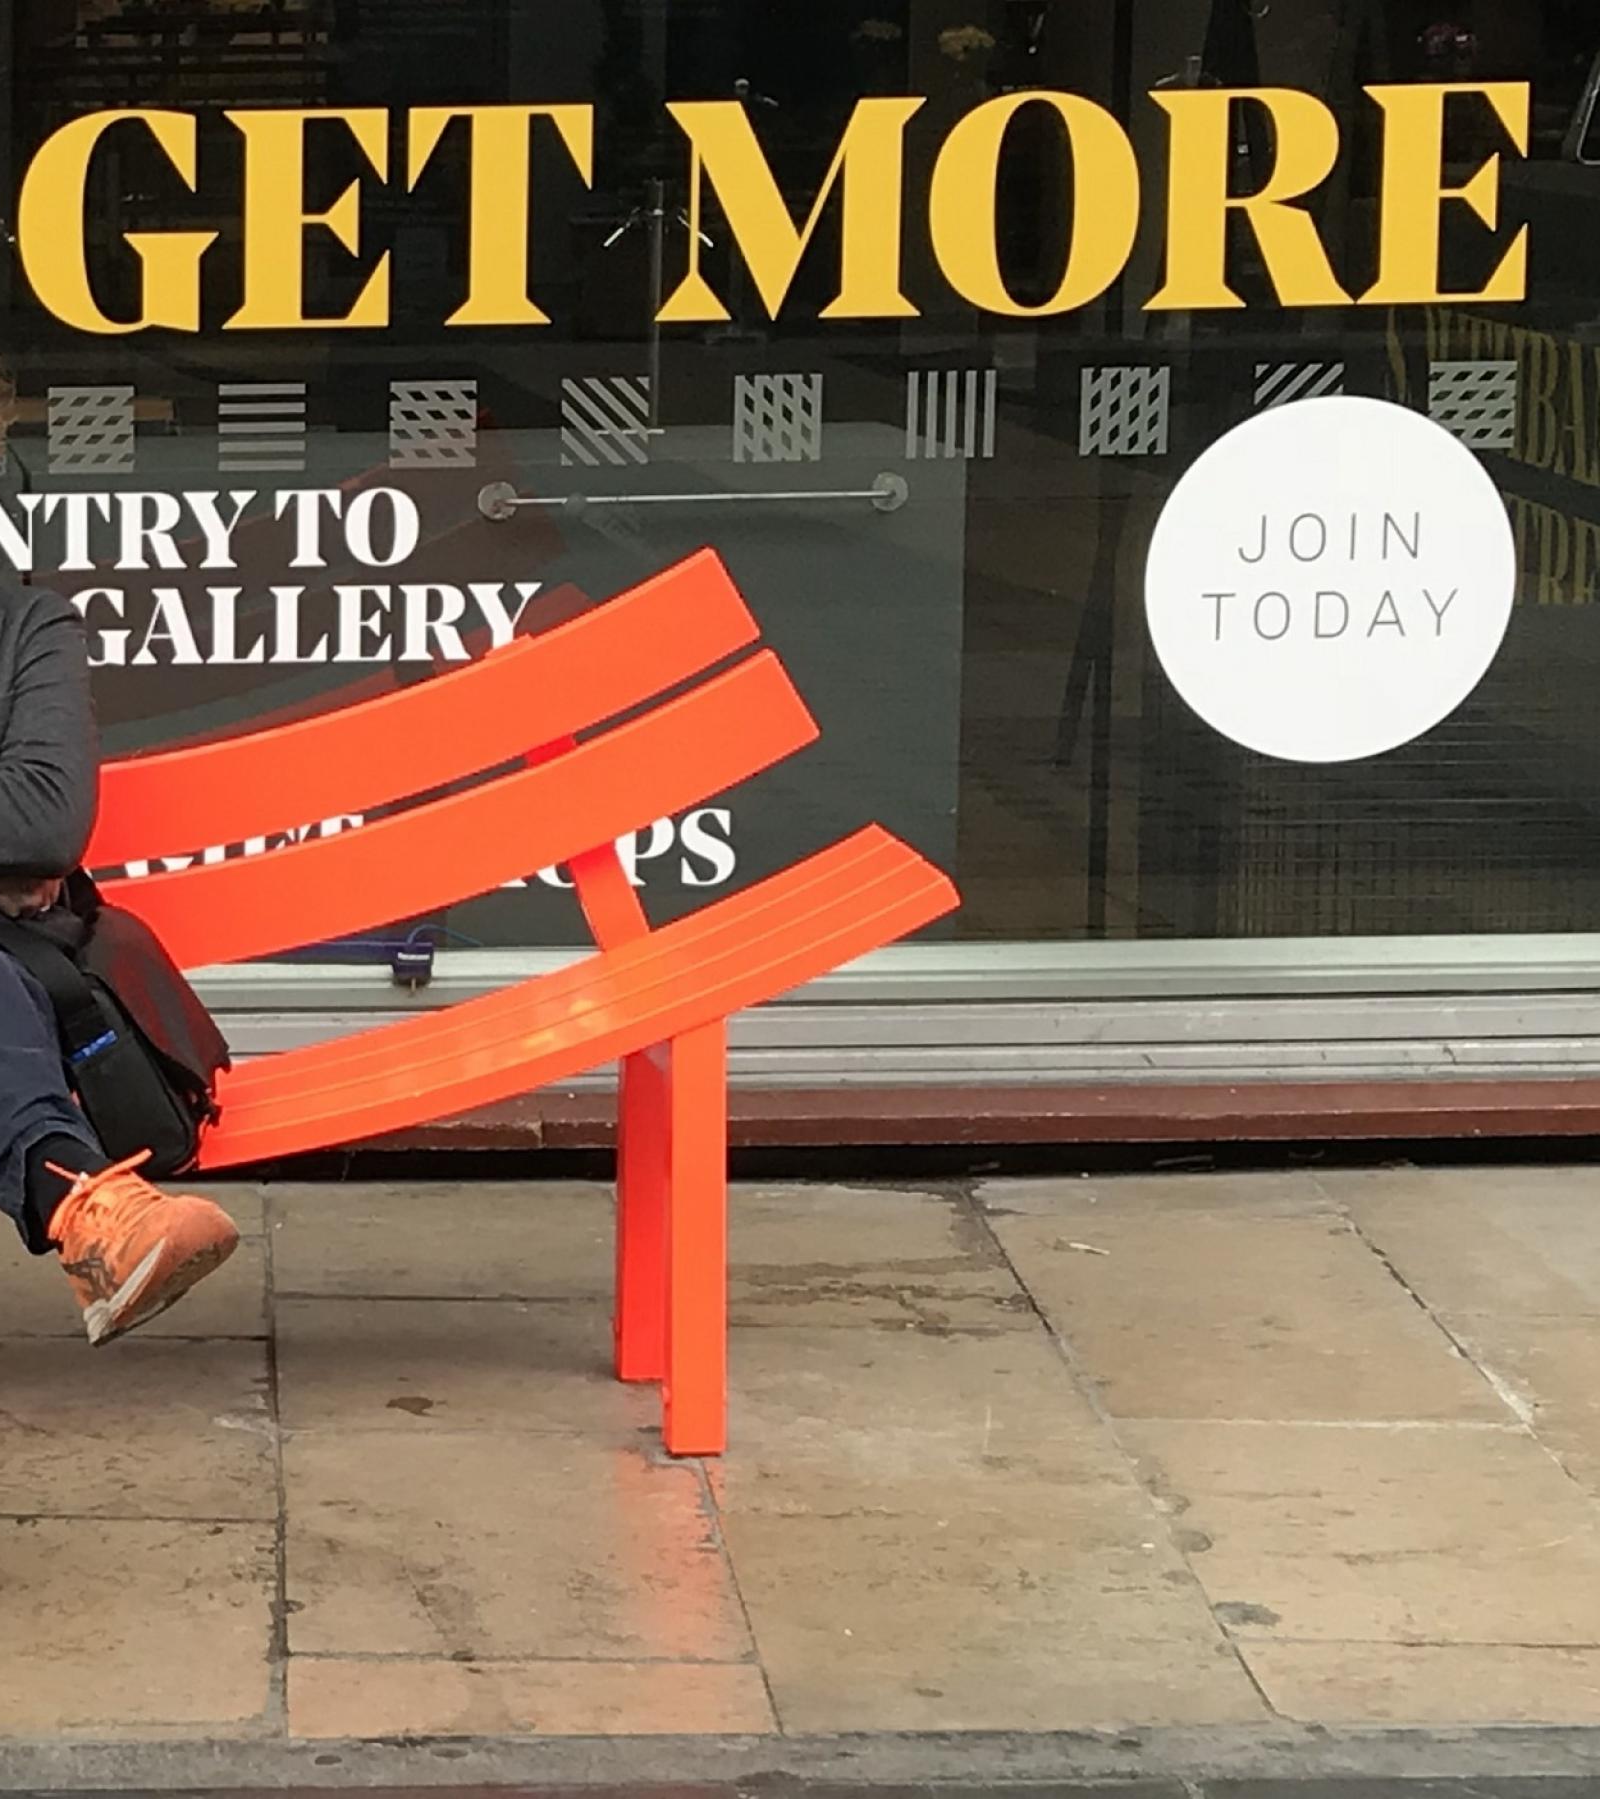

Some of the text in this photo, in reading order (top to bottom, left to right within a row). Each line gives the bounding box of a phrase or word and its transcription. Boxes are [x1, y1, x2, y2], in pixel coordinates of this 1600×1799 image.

[17, 104, 594, 334] GET
[655, 80, 1531, 322] MORE
[275, 487, 420, 567] TO
[1237, 511, 1421, 565] JOIN
[70, 582, 542, 667] GALLERY
[1200, 588, 1459, 642] TODAY
